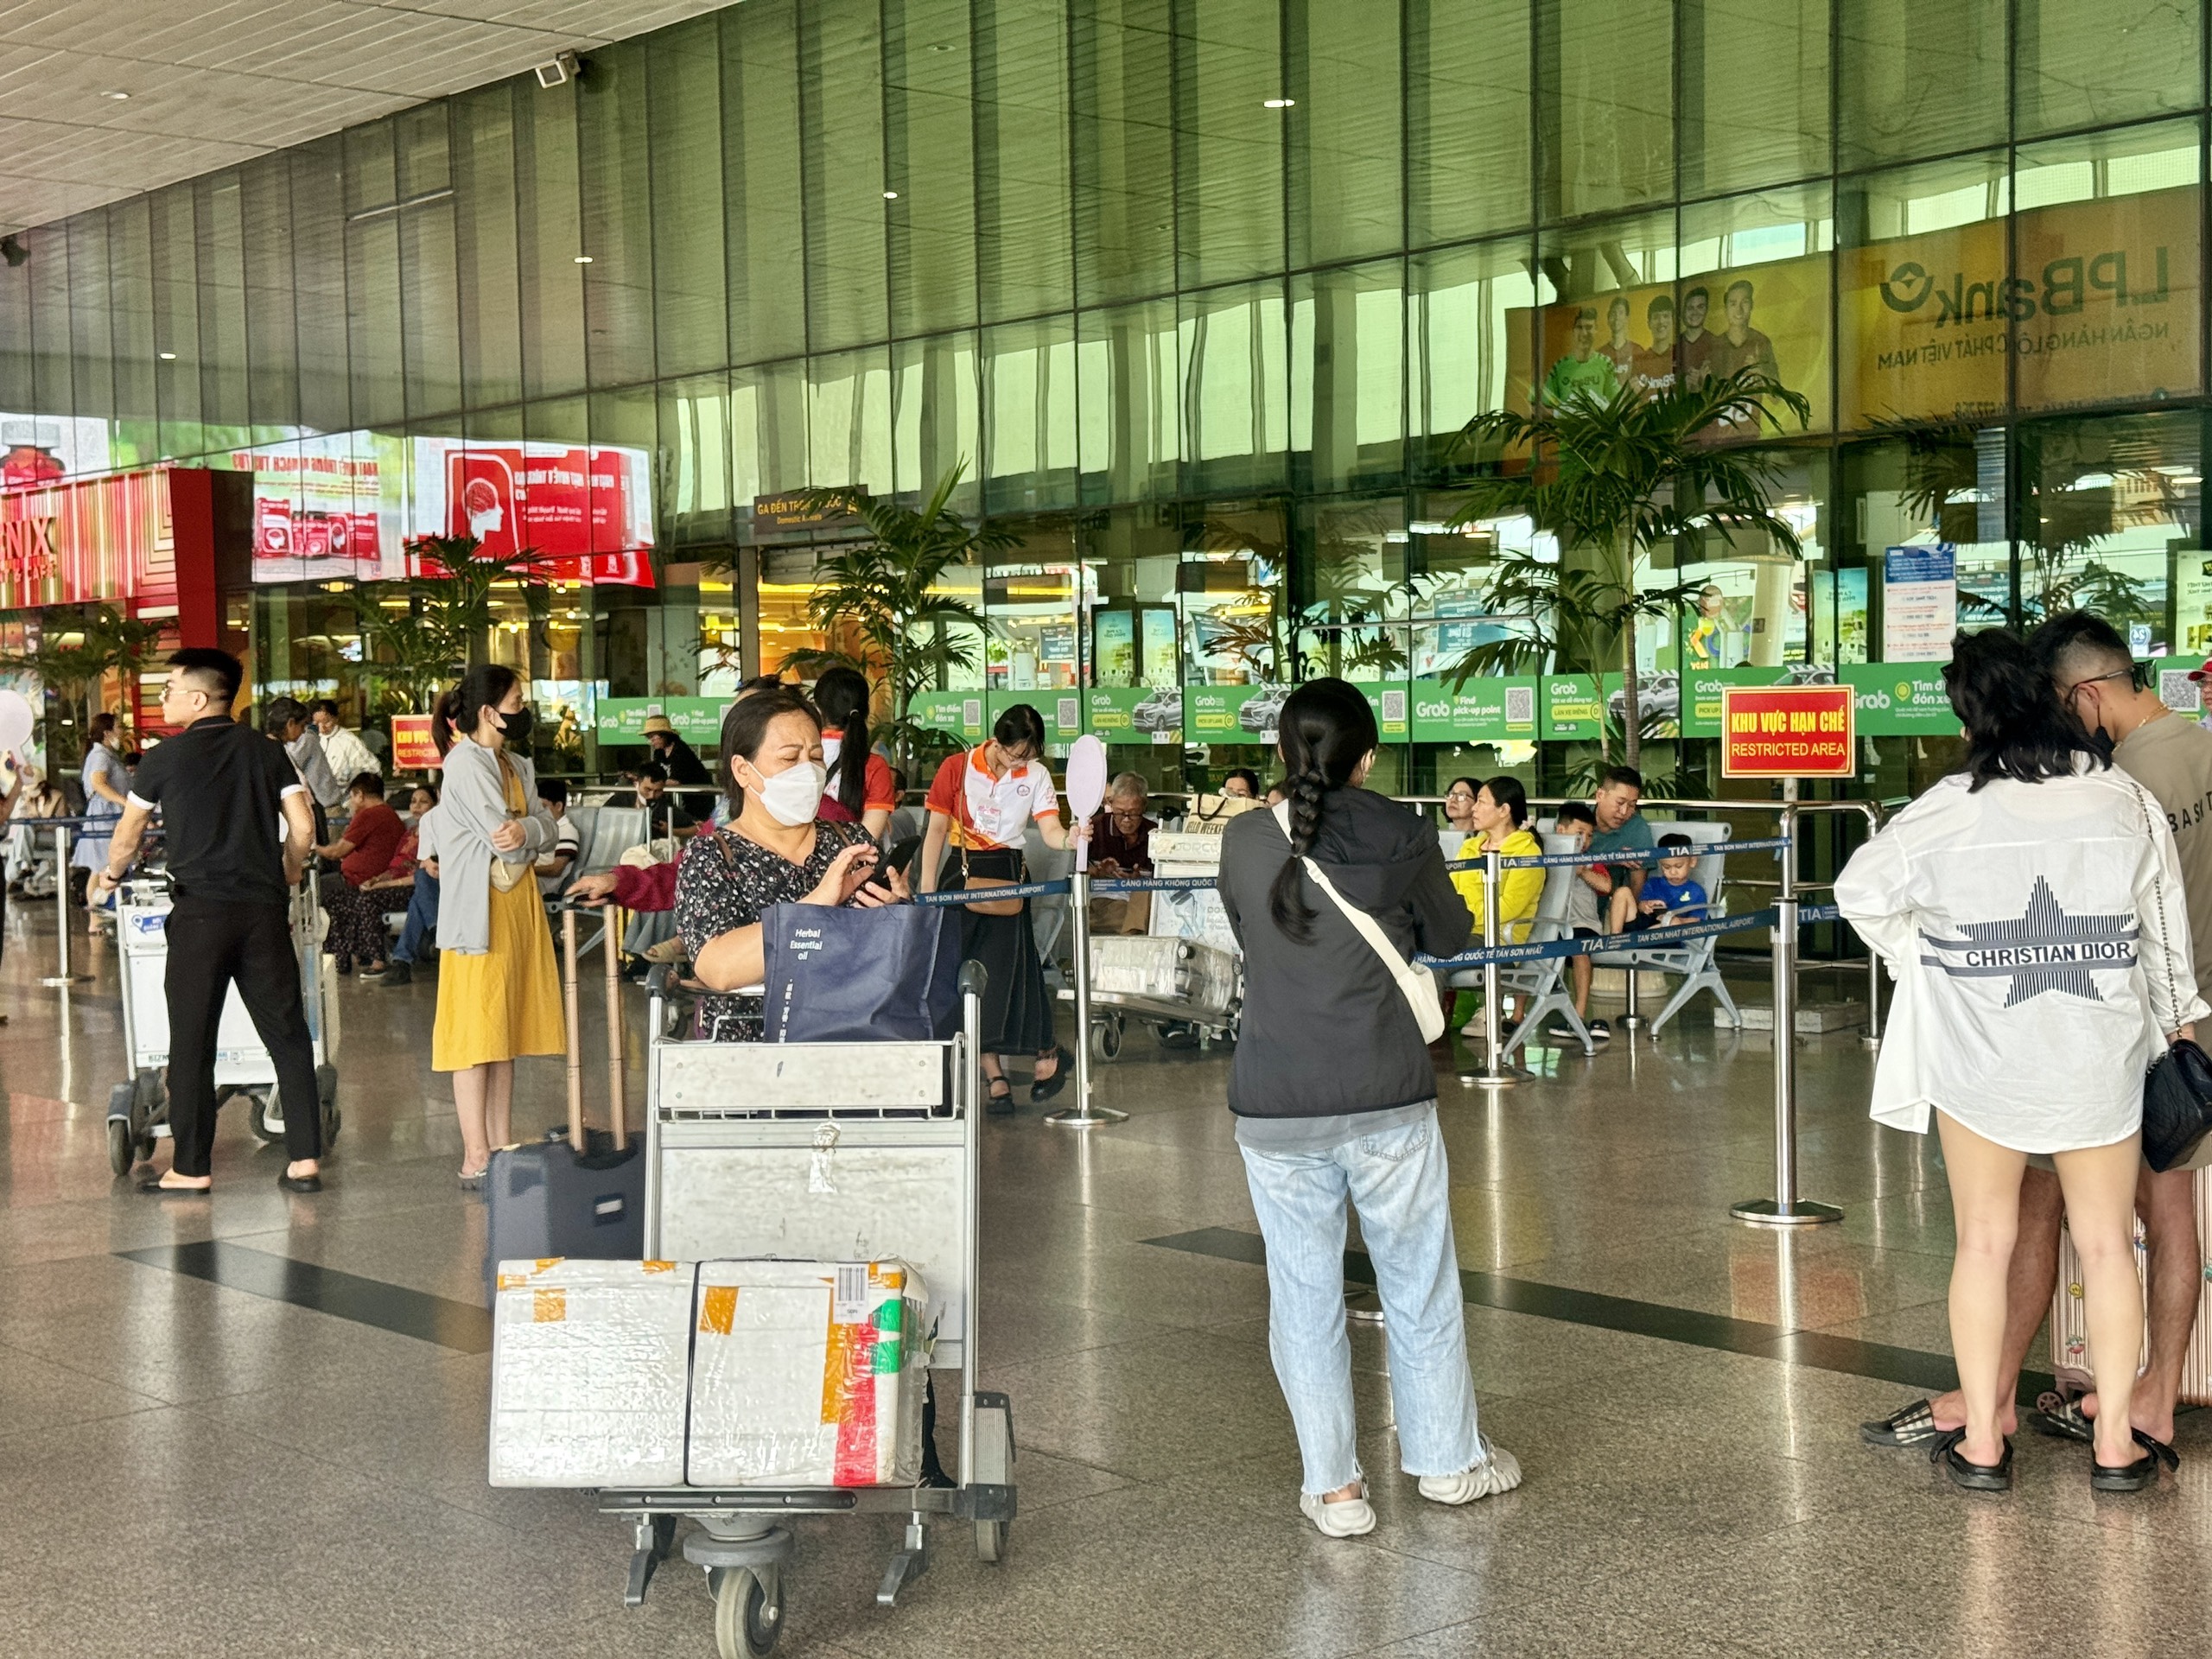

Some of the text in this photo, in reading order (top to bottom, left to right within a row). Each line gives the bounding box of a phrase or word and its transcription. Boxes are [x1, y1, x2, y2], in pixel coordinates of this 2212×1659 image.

[757, 504, 769, 515] GA
[770, 499, 787, 514] ĐẾN
[1550, 681, 1578, 696] Grab
[1694, 678, 1723, 693] Grab
[1912, 679, 1933, 692] Tìm
[1091, 694, 1112, 706] Grab
[1194, 695, 1216, 707] Grab
[1459, 696, 1477, 705] Find
[1854, 690, 1891, 709] rab
[1912, 693, 1936, 705] đón
[1415, 700, 1451, 718] Grab
[1452, 704, 1502, 717] pick-up point
[600, 715, 619, 728] Grab
[670, 712, 690, 727] Grab
[1731, 704, 1846, 736] KHU VỰC HẠN CHẾ
[1732, 742, 1846, 757] RESTRICTED AREA
[1669, 846, 1690, 857] TIA
[1735, 842, 1749, 851] NHAT
[1748, 839, 1787, 849] INTERNATIONAL
[1165, 878, 1191, 887] KHÔNG
[938, 893, 952, 902] SON
[953, 893, 970, 901] NHAT
[970, 889, 1019, 899] INTERNATIONAL
[1019, 884, 1046, 895] AIRPORT
[1799, 908, 1822, 921] TIA
[795, 928, 821, 939] Herbal
[1580, 939, 1605, 953] TIA
[1637, 933, 1650, 944] TAN
[1650, 931, 1664, 942] SON
[1665, 929, 1681, 939] NHAT
[1681, 922, 1728, 938] INTERNATIONAL
[1728, 916, 1756, 929] AIRPORT
[790, 940, 823, 951] Essential
[1464, 949, 1485, 962] QUỐC
[1485, 948, 1496, 959] TẾ
[1496, 949, 1510, 958] TÂN
[1510, 947, 1525, 957] SƠN
[1525, 944, 1545, 956] NHẤT
[798, 951, 809, 961] oil
[1966, 941, 2131, 968] CHRISTIAN DIOR
